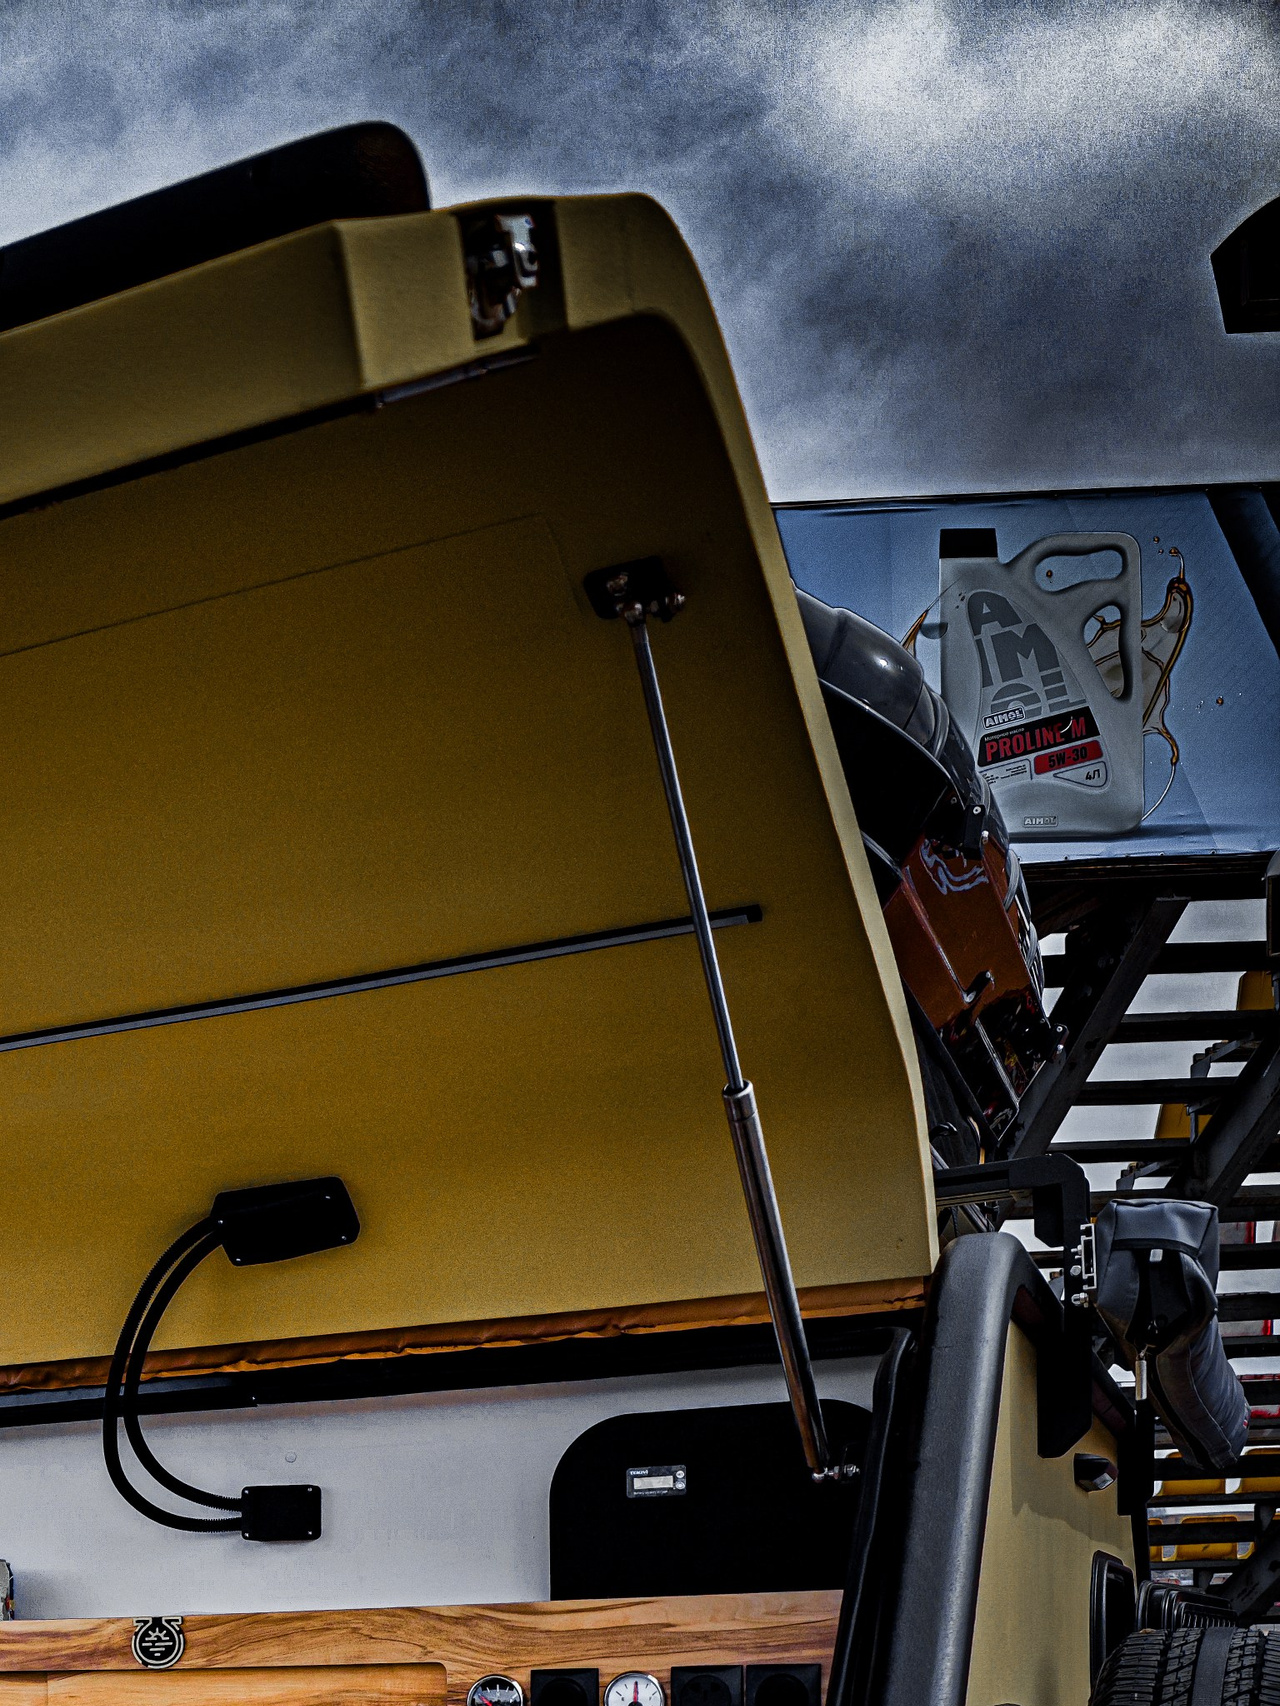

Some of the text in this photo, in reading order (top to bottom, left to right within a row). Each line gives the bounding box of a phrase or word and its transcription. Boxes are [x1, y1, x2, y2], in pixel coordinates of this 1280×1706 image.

[985, 708, 1024, 727] AIMOL
[985, 717, 1087, 762] PROLINE M
[1048, 747, 1088, 768] 5W-30
[1024, 817, 1057, 826] AIMOL
